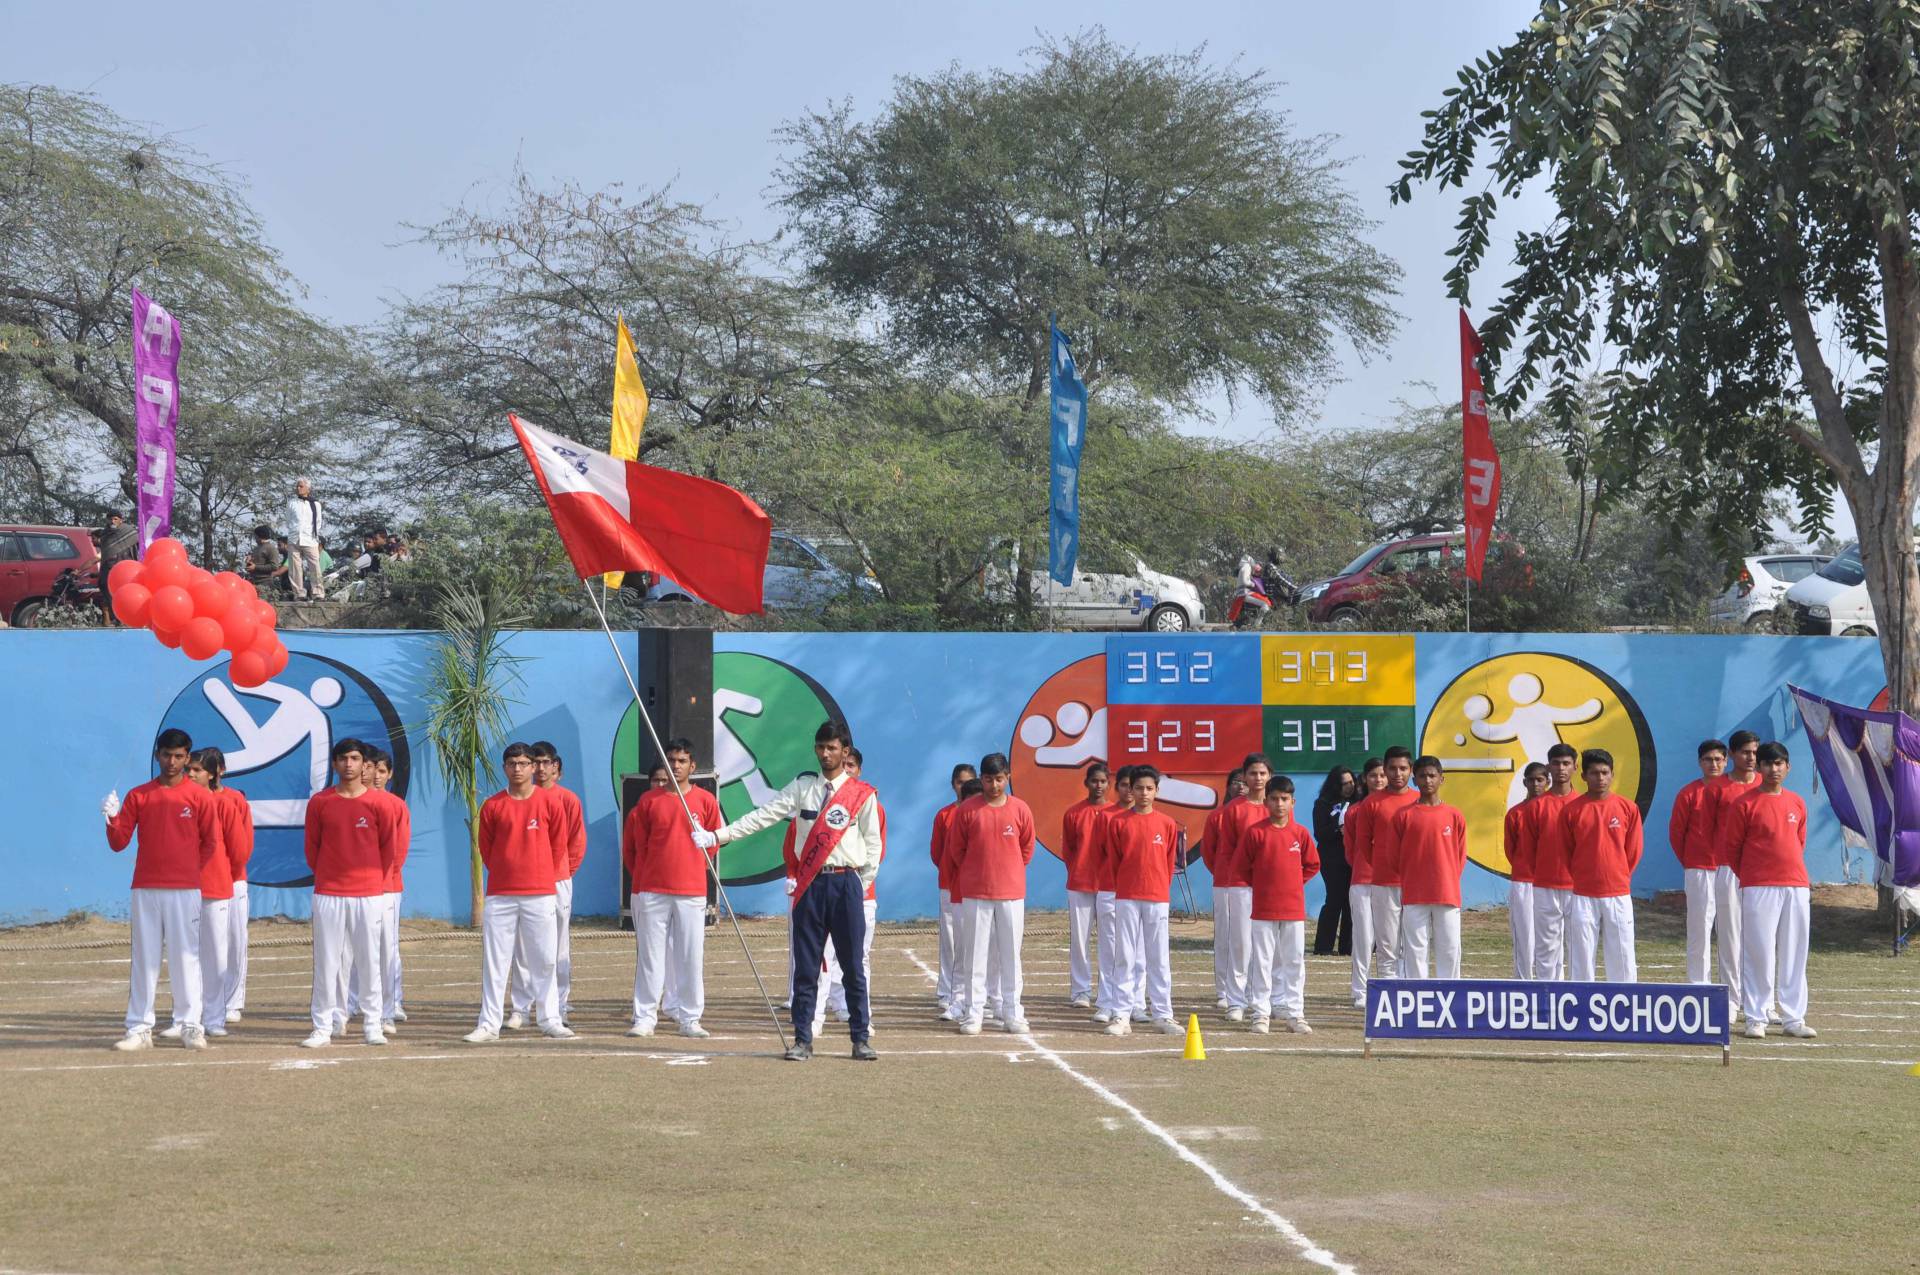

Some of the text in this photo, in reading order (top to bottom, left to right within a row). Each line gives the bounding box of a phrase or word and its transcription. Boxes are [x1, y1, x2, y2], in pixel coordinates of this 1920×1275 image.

[1127, 651, 1212, 683] 352
[1128, 720, 1215, 752] 323
[1283, 720, 1369, 751] 381
[1374, 990, 1722, 1034] APEX PUBLIC SCHOOL
